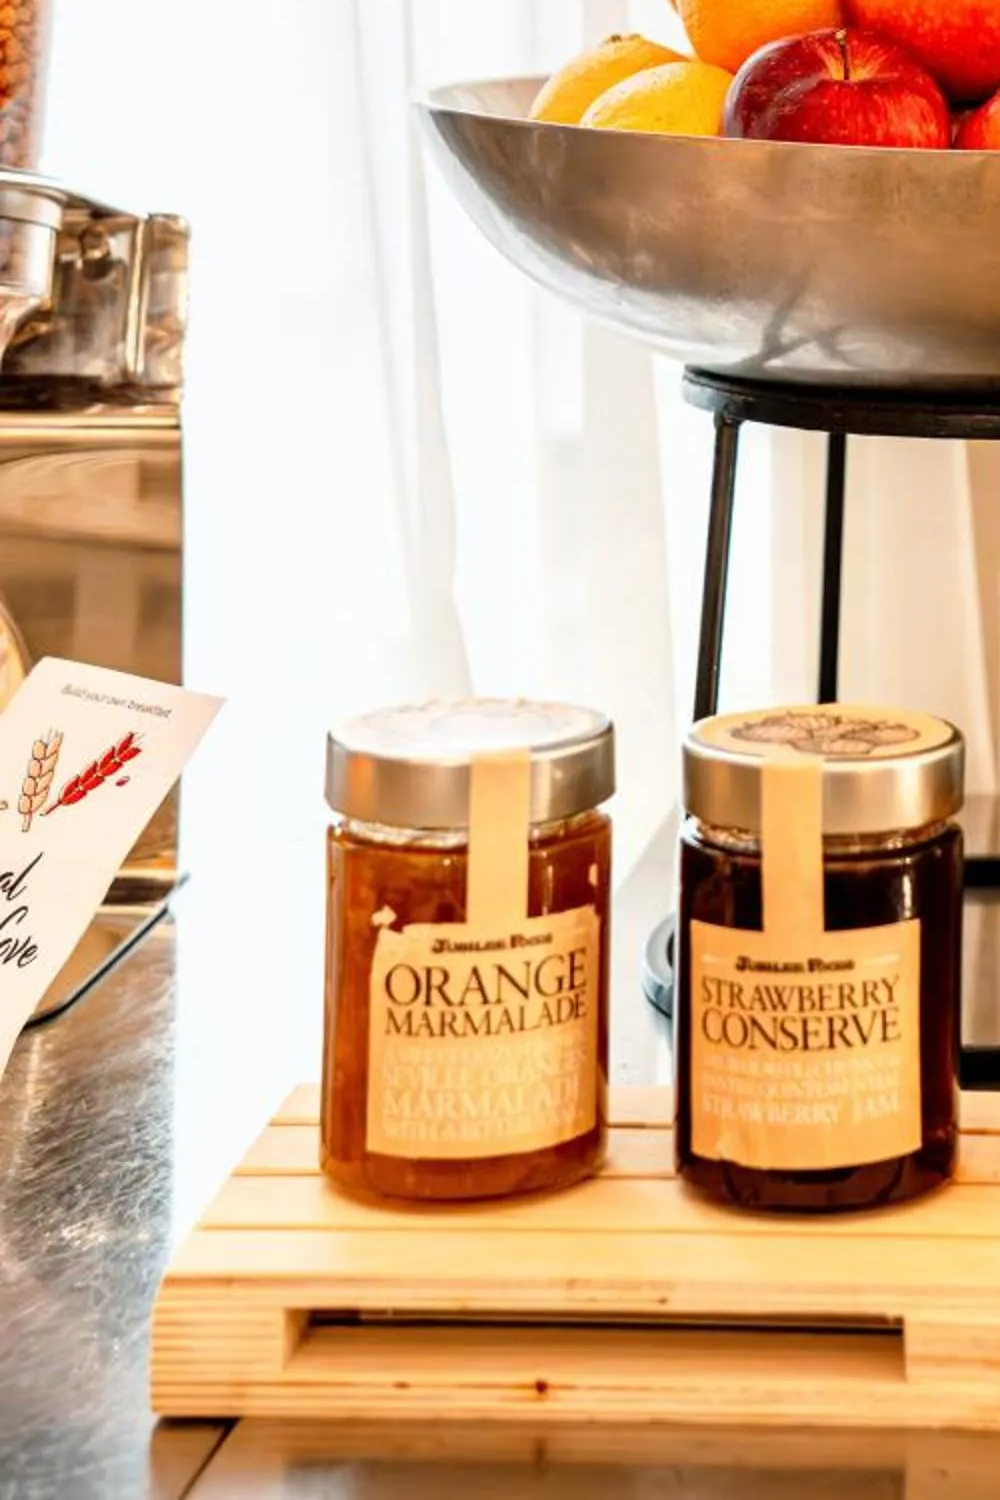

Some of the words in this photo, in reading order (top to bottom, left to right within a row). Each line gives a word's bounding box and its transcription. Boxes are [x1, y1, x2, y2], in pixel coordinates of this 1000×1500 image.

[384, 947, 588, 1007] ORANGE
[701, 975, 900, 1013] STRAWBERRY
[384, 993, 587, 1038] MARMALADE
[701, 1007, 902, 1052] CONSERVE
